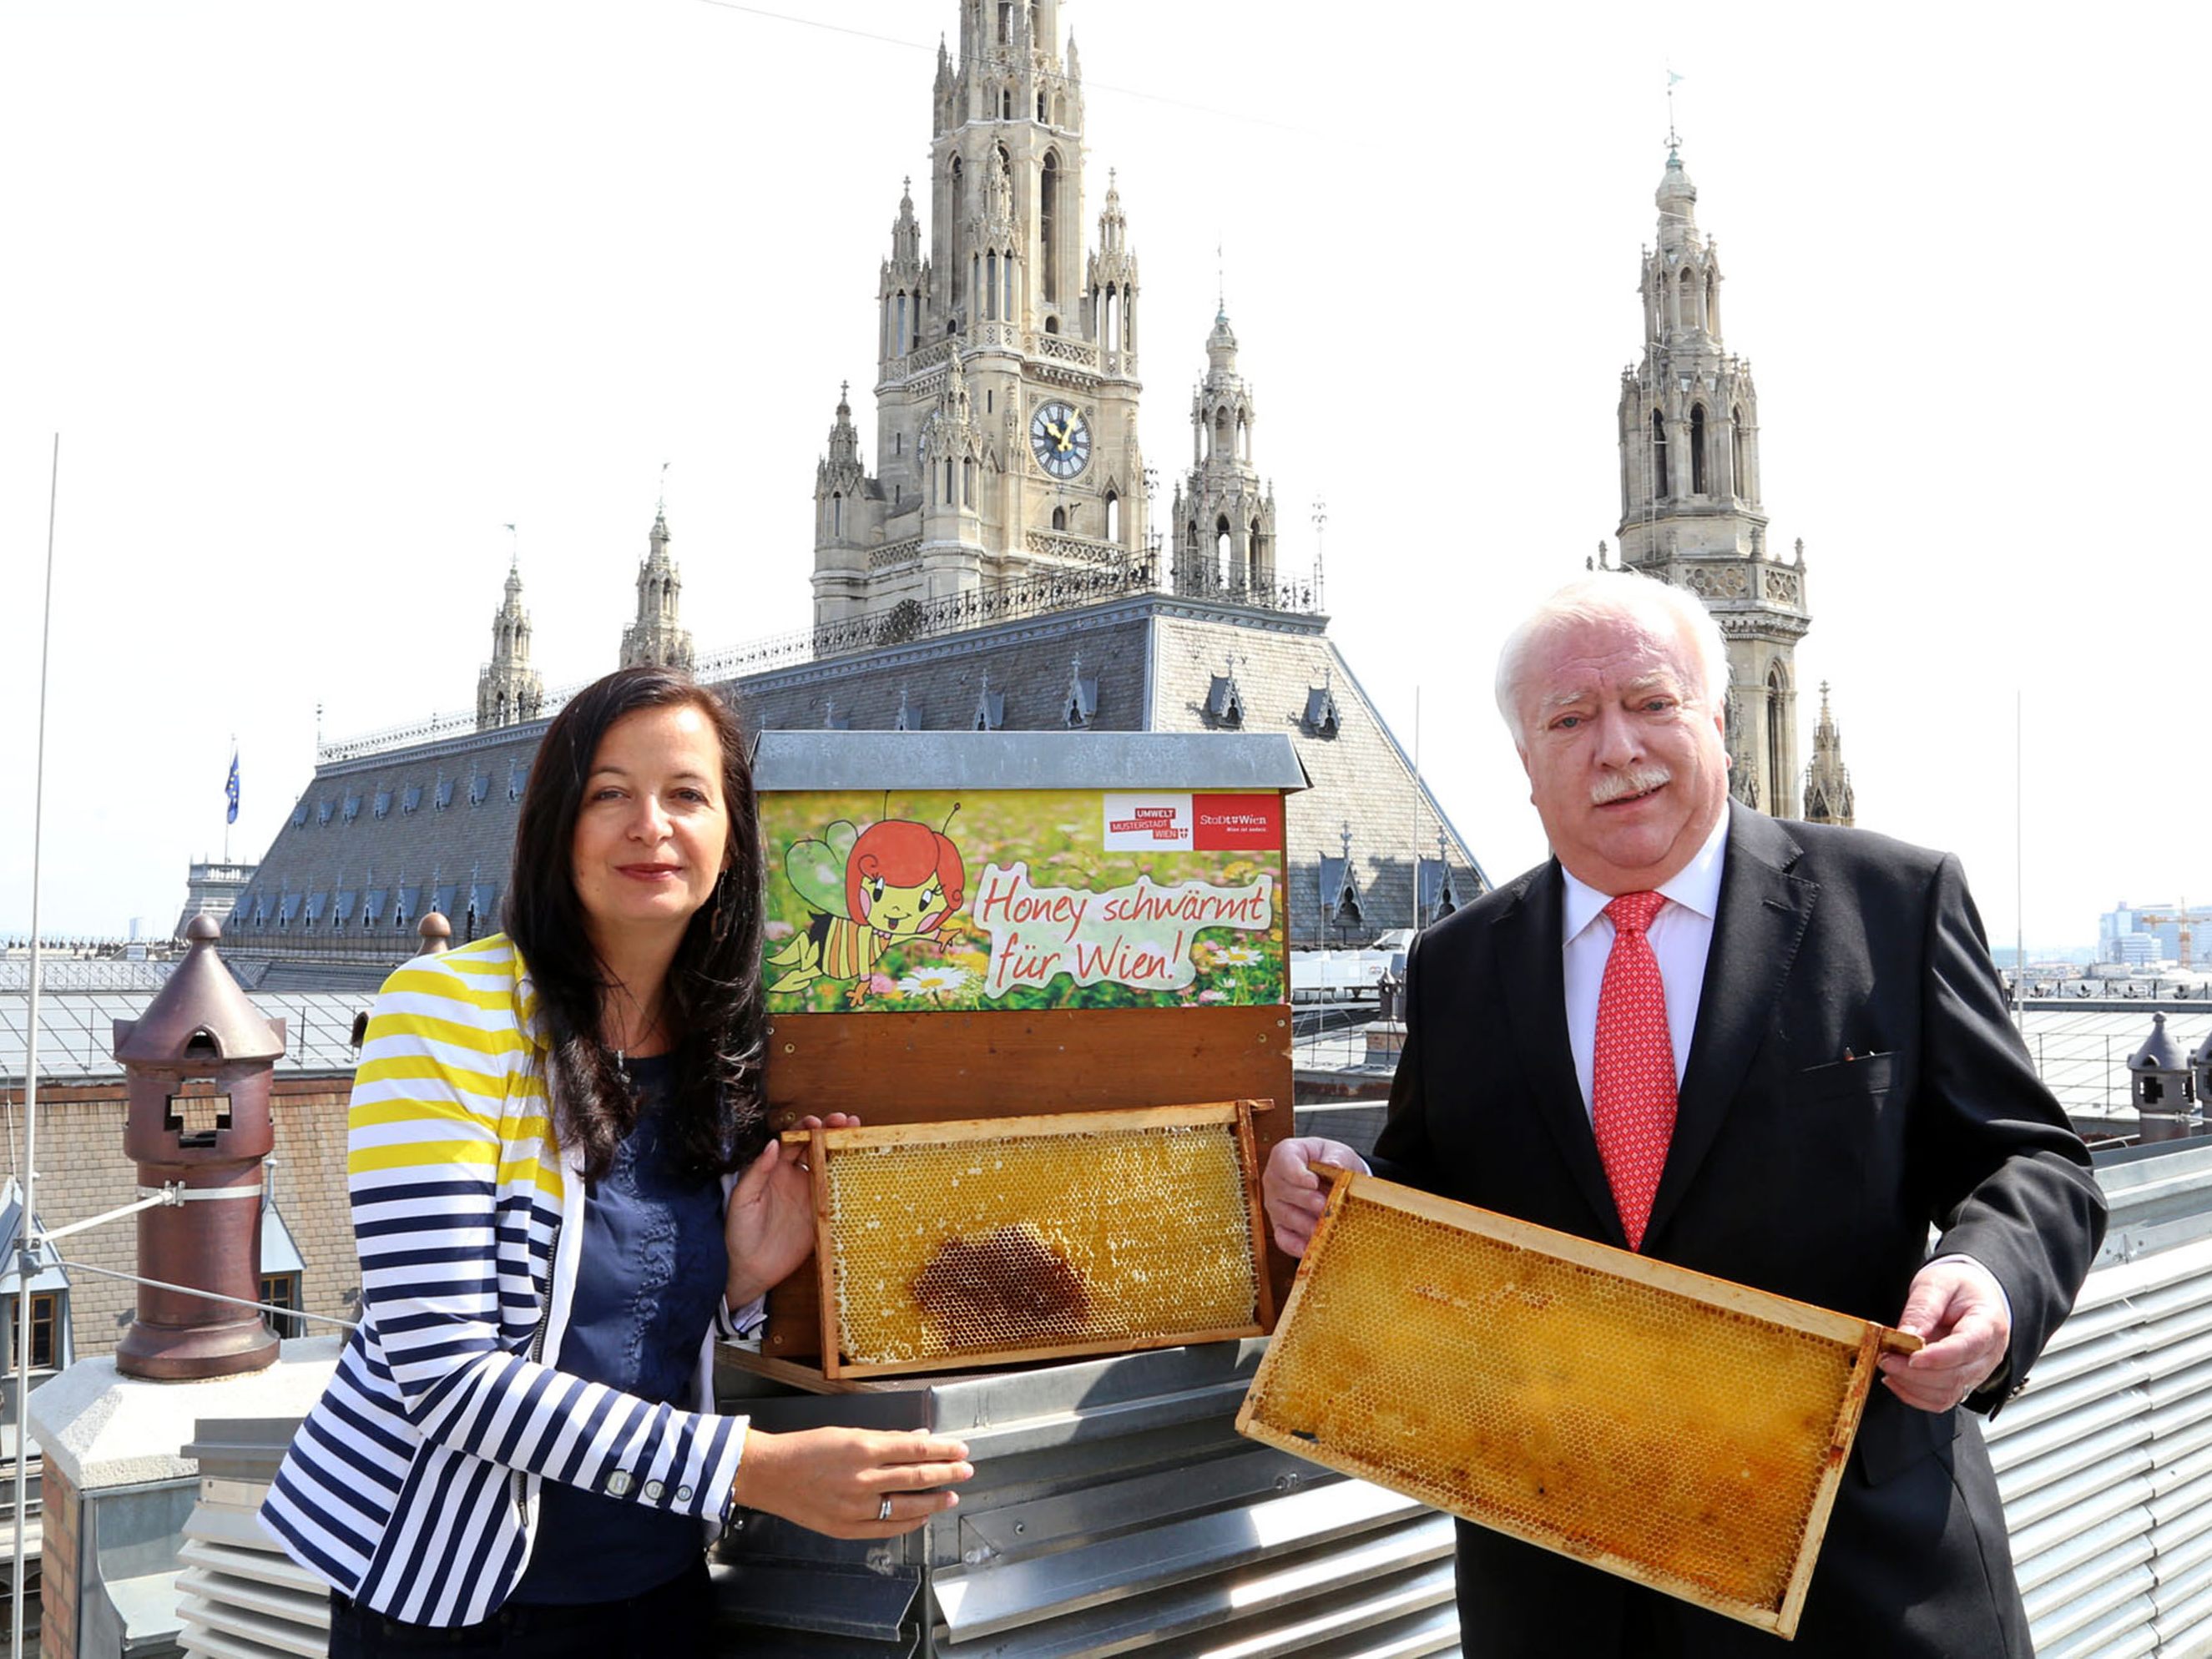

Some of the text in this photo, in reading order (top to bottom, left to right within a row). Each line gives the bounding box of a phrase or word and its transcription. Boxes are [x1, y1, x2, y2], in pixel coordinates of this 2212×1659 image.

[1137, 809, 1174, 818] UMWELT
[1240, 814, 1265, 824] Wien
[1112, 819, 1167, 830] MUSTERSTADT
[1155, 830, 1177, 838] WIEN
[983, 875, 1265, 944] Honey schwärmt
[997, 930, 1183, 988] für Wien!
